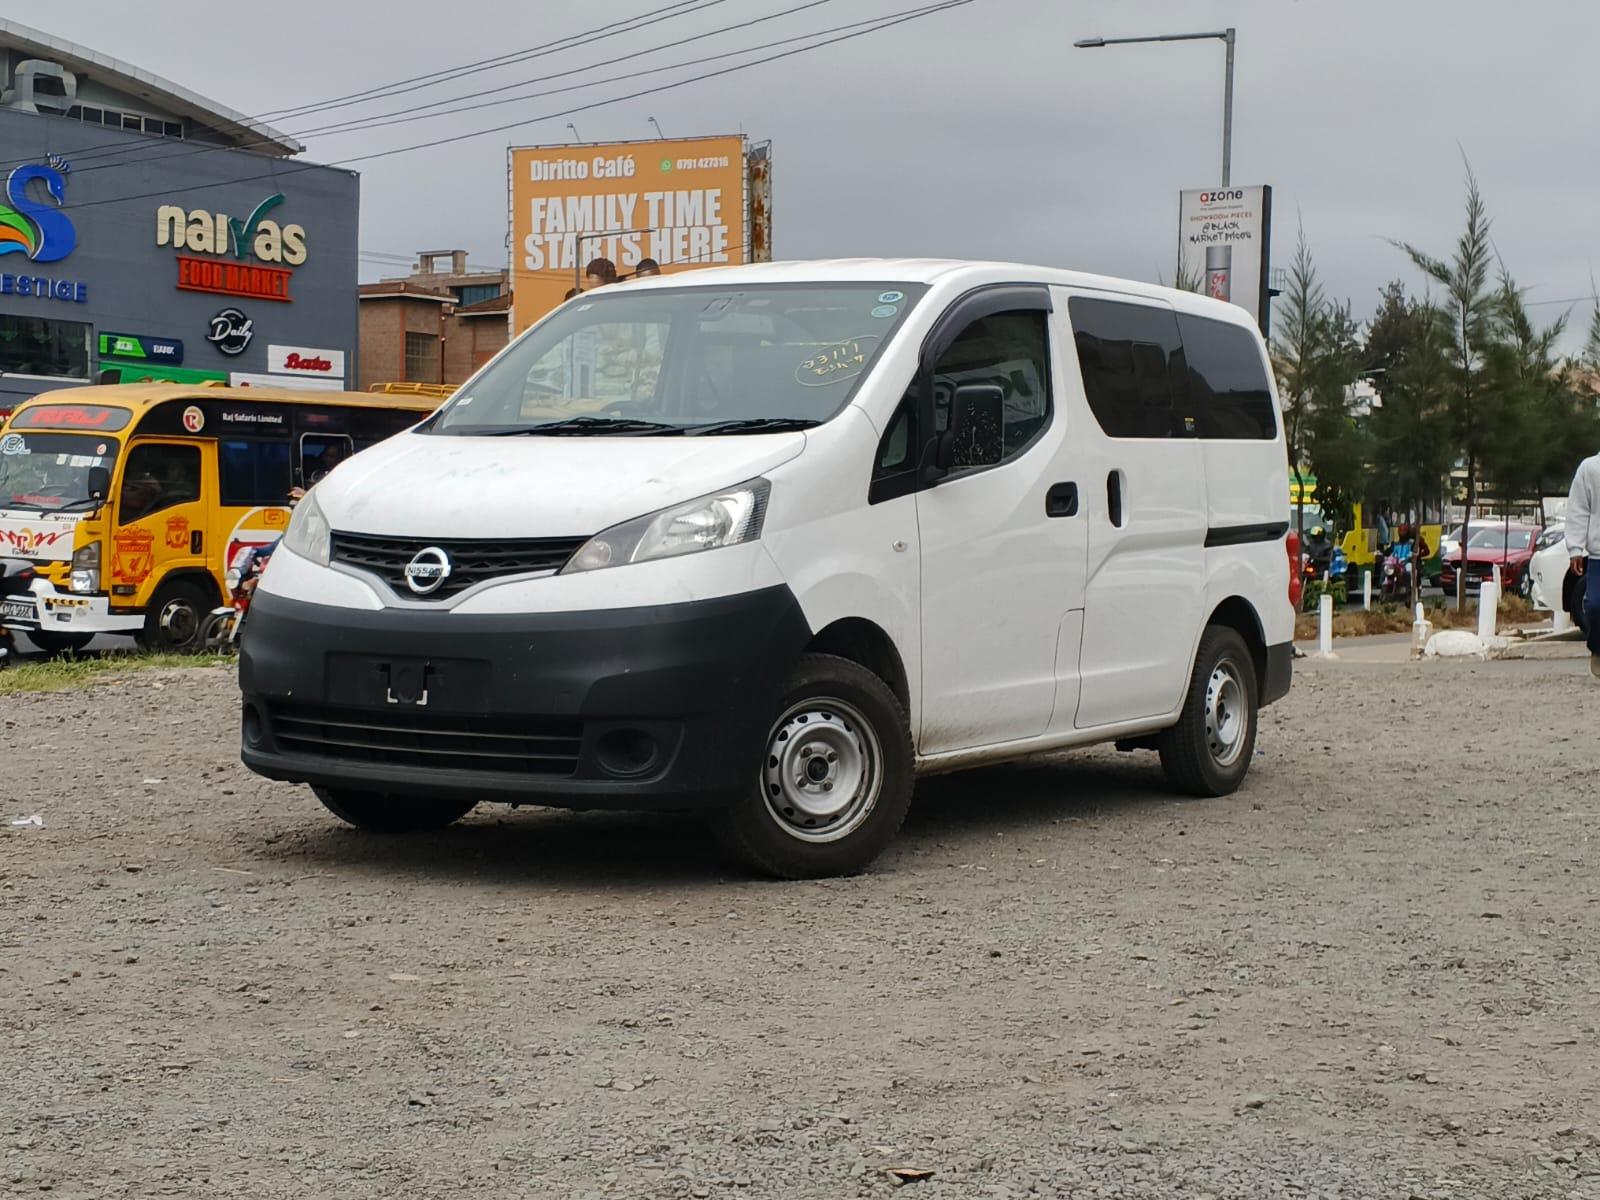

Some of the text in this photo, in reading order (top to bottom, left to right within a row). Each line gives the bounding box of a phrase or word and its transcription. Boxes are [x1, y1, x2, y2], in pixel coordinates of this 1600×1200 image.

[530, 154, 635, 181] Diritto Café
[1200, 190, 1243, 202] azone
[531, 188, 722, 234] FAMILY TIME
[524, 225, 729, 271] STARTS HERE
[179, 258, 292, 298] FOOD MARKET
[208, 317, 253, 348] Daily
[284, 353, 332, 372] Bata
[408, 566, 443, 577] NISSAN
